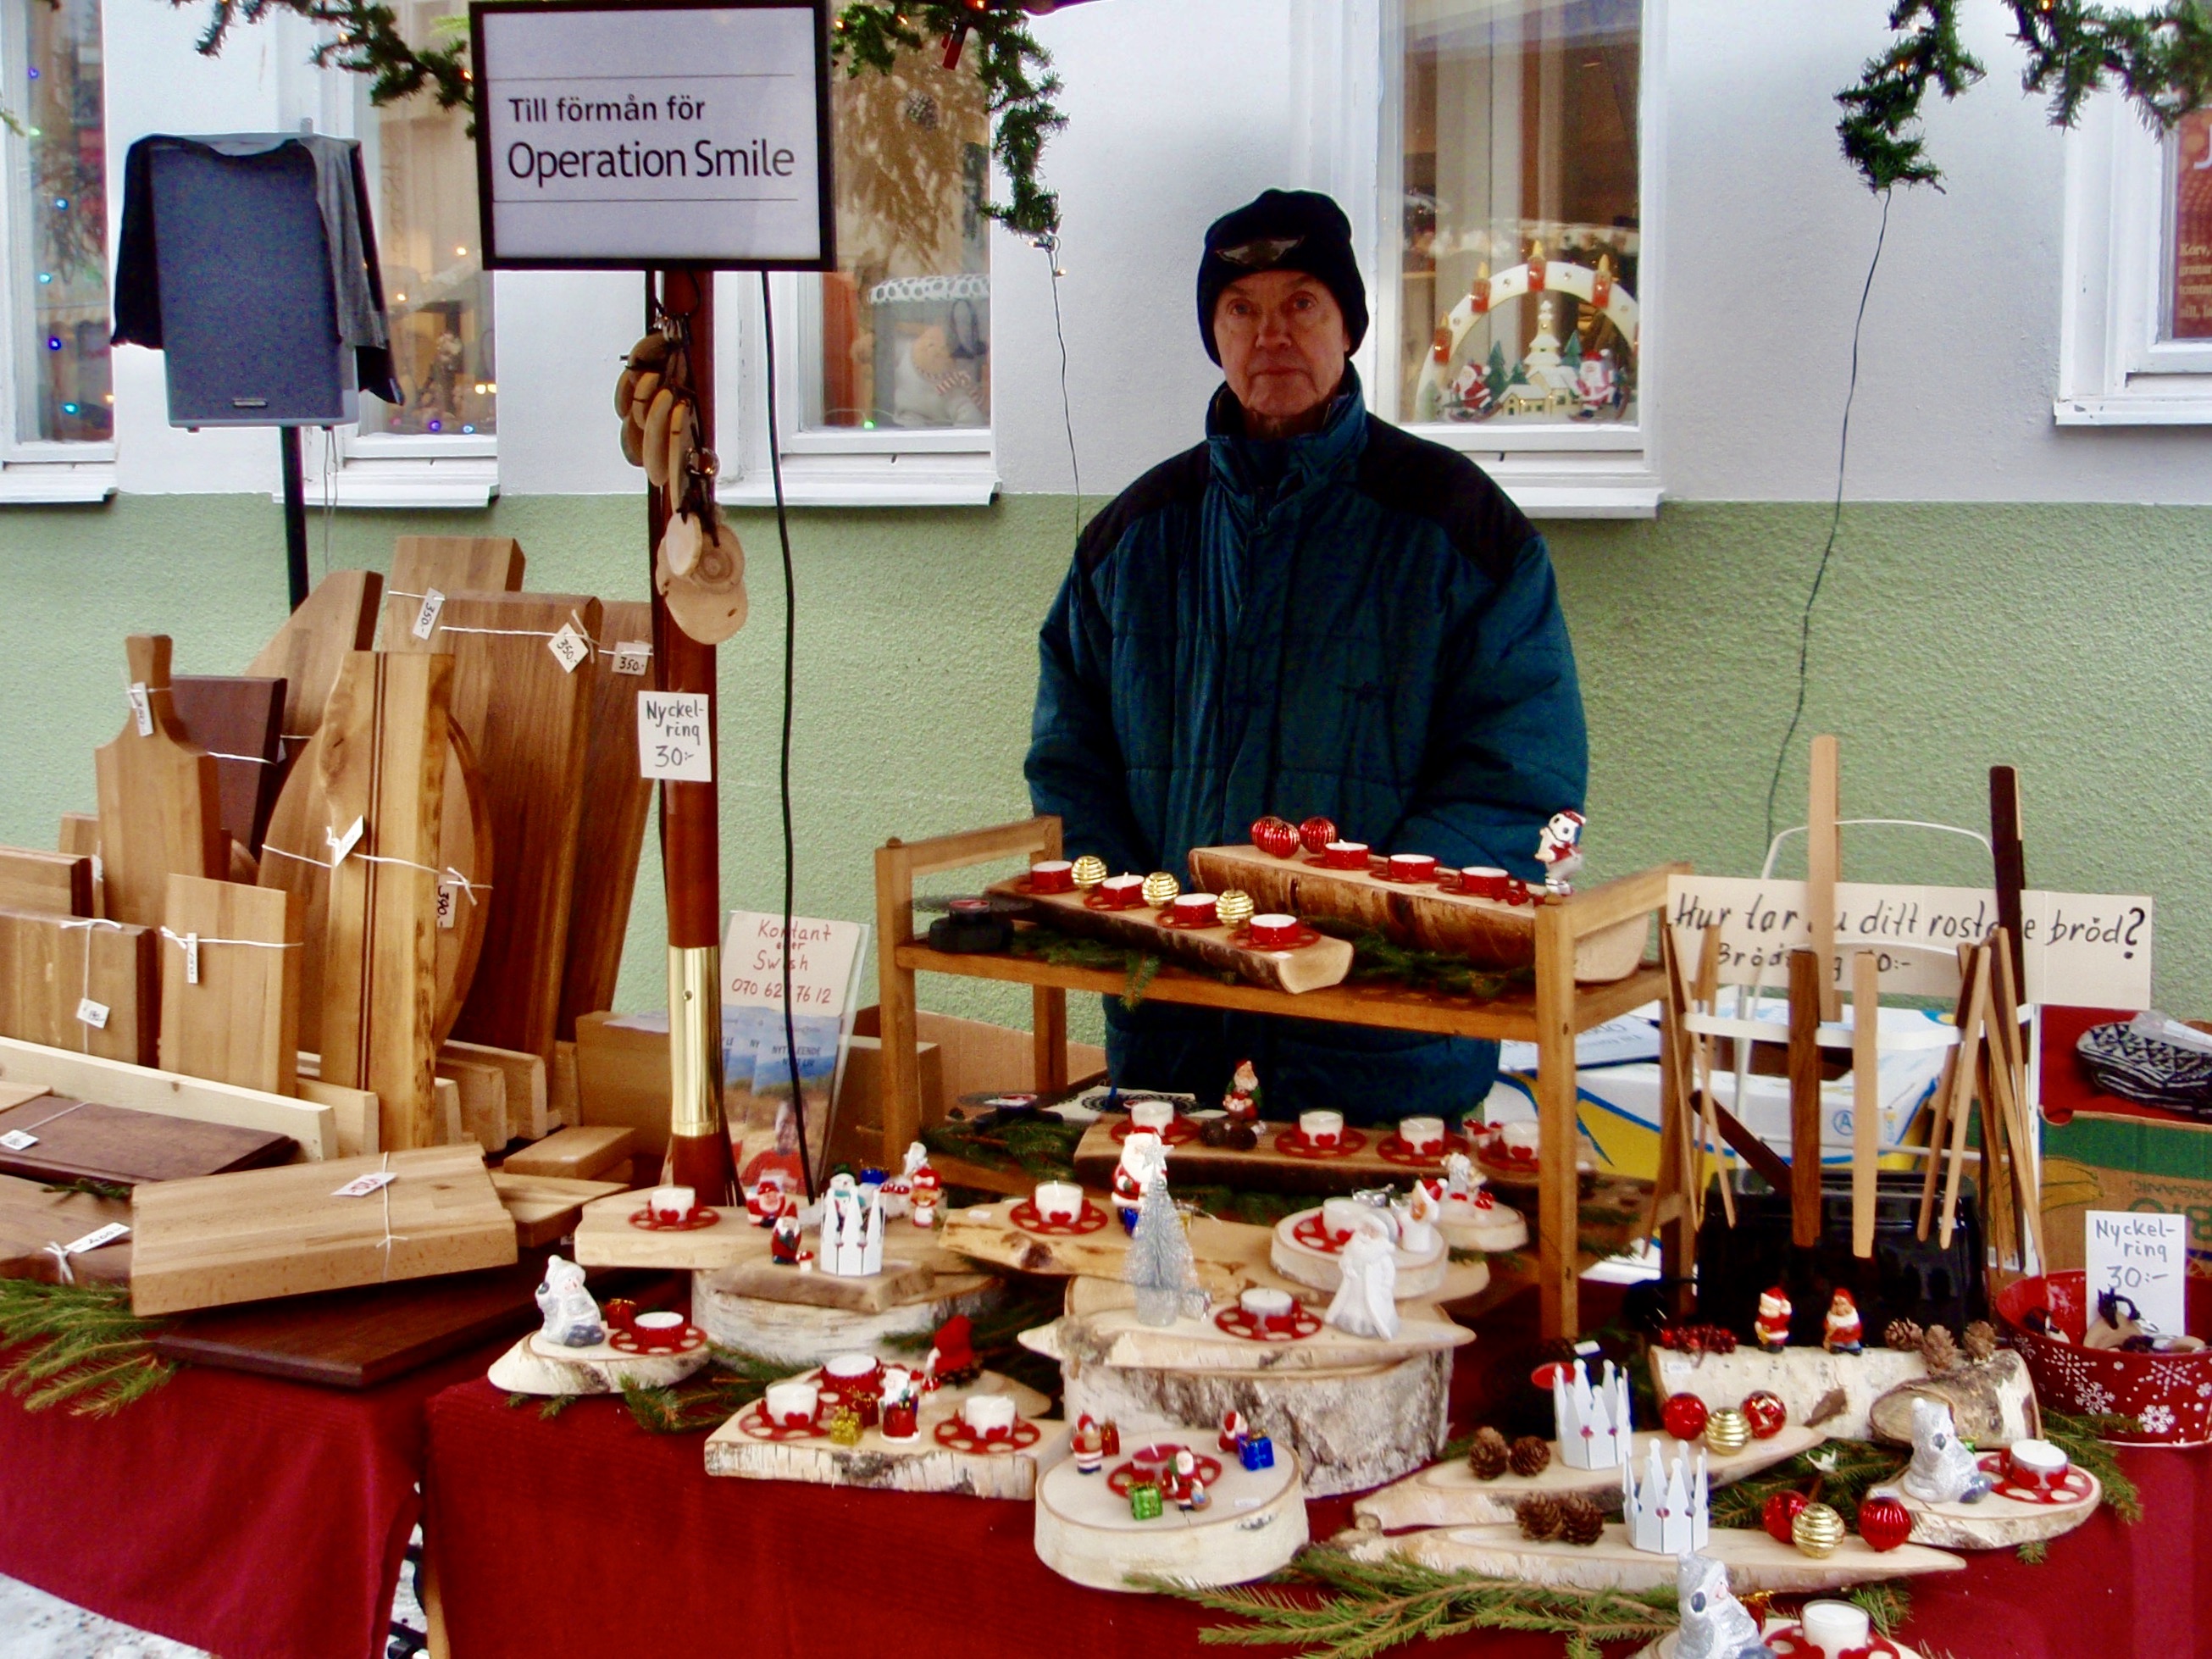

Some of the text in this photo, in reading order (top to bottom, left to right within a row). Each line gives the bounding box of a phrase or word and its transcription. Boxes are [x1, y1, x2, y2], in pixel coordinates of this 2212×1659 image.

[508, 93, 706, 122] Till förmån för
[507, 137, 796, 188] Operation Smile
[646, 699, 705, 728] Nyckel-
[666, 721, 701, 746] ring
[655, 745, 695, 768] 30:-
[1675, 891, 1732, 930] Hur
[1745, 893, 1799, 933] tar
[1860, 899, 1920, 936] ditt
[1928, 899, 2036, 940] roste
[2043, 906, 2146, 960] bröd?
[775, 941, 806, 951] eer
[752, 949, 809, 971] Swsh
[731, 978, 832, 1004] 070 62 76 12
[772, 1045, 789, 1055] NYT
[2096, 1218, 2176, 1247] Nyckel-
[2124, 1240, 2167, 1262] ring
[2106, 1265, 2169, 1289] 30:-
